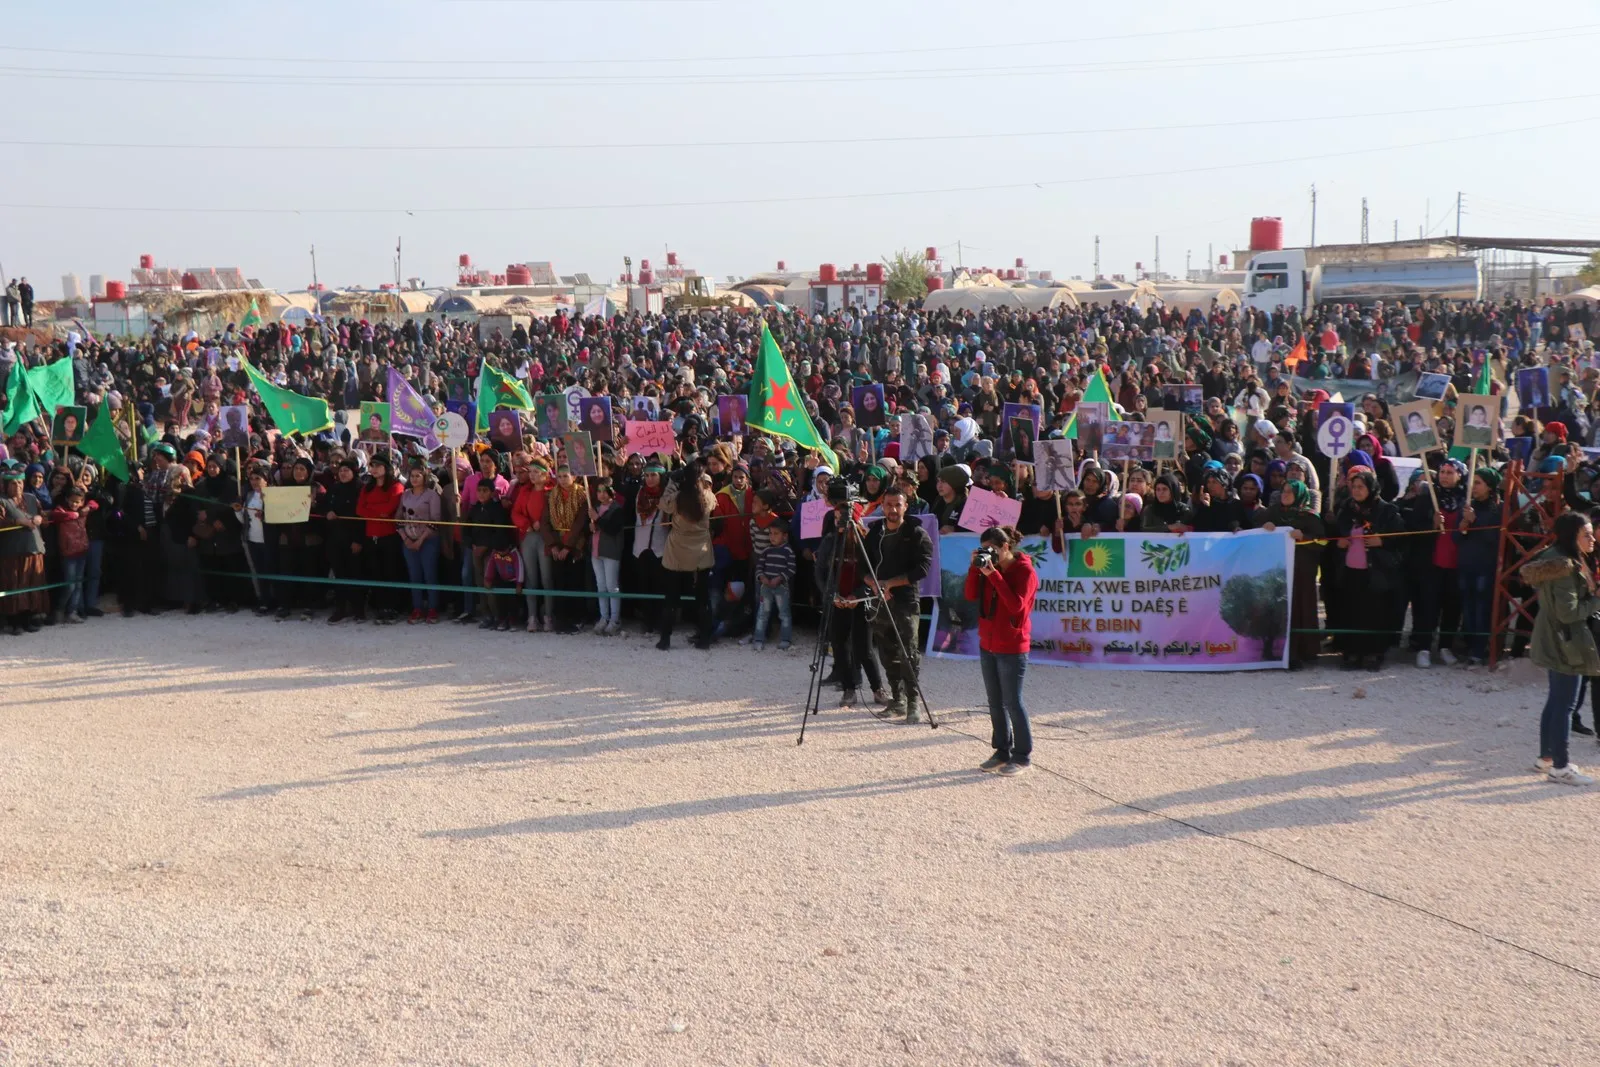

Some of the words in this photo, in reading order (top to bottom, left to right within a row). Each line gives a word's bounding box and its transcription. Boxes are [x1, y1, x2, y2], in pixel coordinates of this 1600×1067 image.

[1092, 580, 1130, 594] XWE
[1135, 574, 1221, 593] BIPARÊZIN
[1034, 597, 1103, 612] IRKERIYÊ
[1111, 600, 1123, 612] U
[1131, 597, 1174, 618] DAÊŞ
[1060, 616, 1092, 632] TÊK
[1096, 618, 1141, 633] BIBIN
